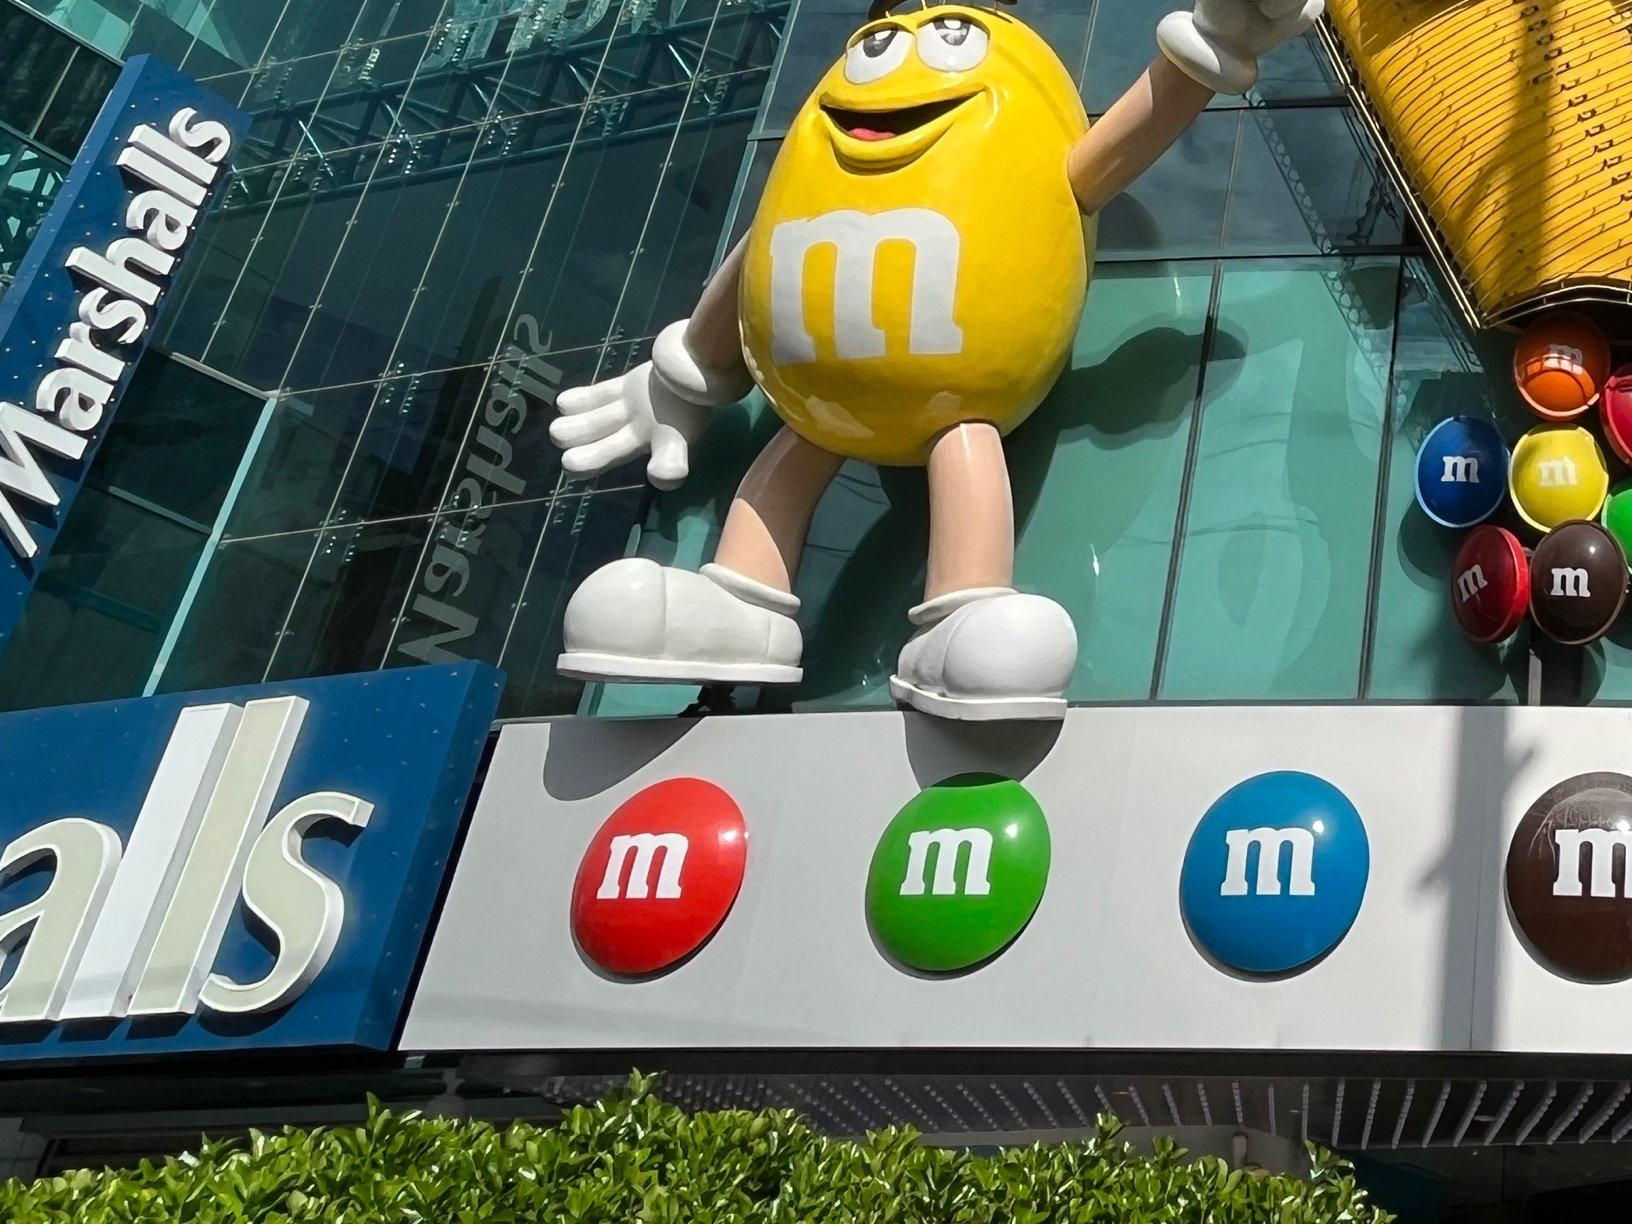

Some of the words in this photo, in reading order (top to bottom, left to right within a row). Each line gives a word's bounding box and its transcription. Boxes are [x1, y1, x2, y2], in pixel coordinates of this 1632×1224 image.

[769, 207, 963, 366] m
[0, 107, 232, 559] Marshalls
[1440, 452, 1480, 484] m
[1538, 457, 1578, 488] m
[1456, 562, 1489, 603] m
[1550, 565, 1591, 599] m
[596, 831, 690, 900] m
[899, 827, 994, 897] m
[1219, 826, 1317, 897] m
